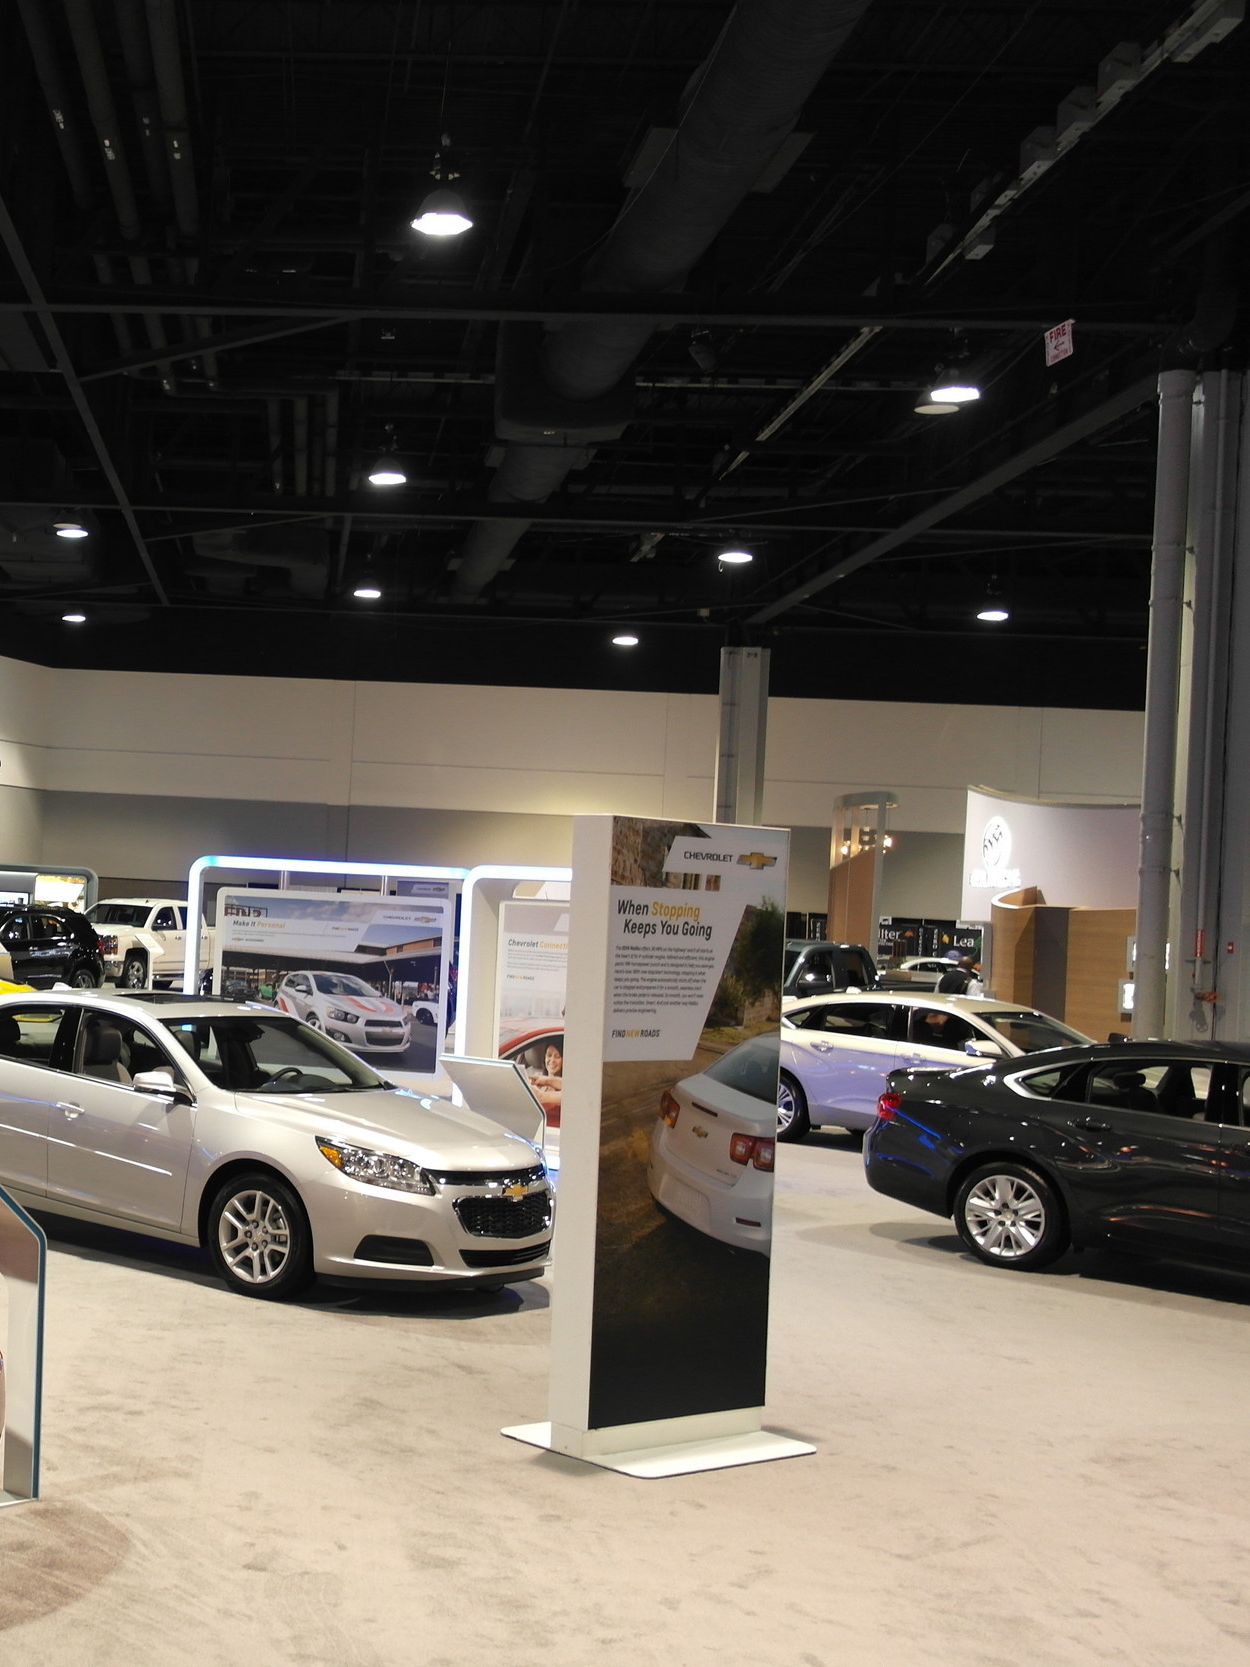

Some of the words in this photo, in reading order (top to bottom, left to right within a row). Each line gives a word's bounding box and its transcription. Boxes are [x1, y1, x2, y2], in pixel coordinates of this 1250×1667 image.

[1049, 324, 1066, 343] FIRE
[684, 851, 733, 862] CHEVROLET
[618, 900, 649, 915] When
[651, 901, 701, 922] Stopping
[257, 921, 286, 929] Personal
[623, 919, 657, 939] Keeps
[660, 921, 681, 935] You
[682, 921, 712, 941] Going
[508, 939, 539, 948] Chevrolet
[612, 1030, 626, 1038] FIND
[640, 1030, 660, 1038] ROADS
